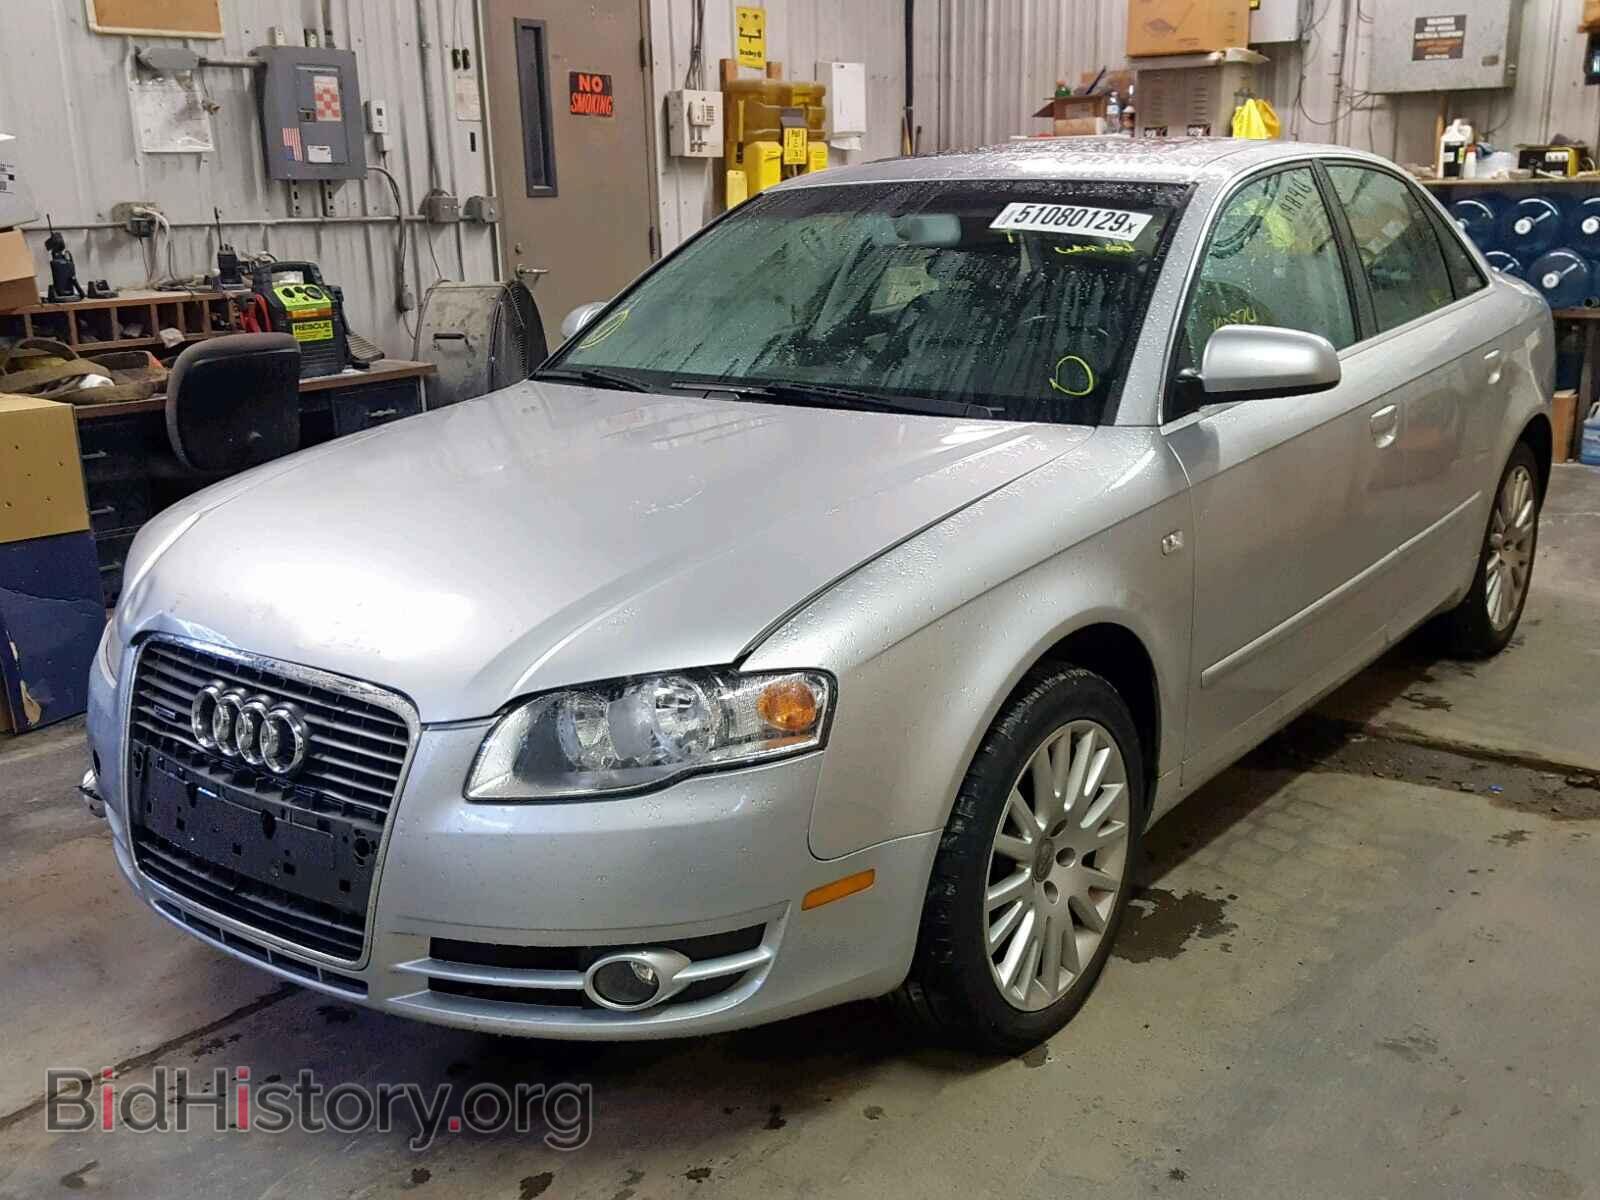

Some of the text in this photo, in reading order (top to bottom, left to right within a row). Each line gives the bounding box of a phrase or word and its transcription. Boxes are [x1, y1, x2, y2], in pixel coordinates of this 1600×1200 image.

[579, 74, 603, 93] NO
[571, 92, 613, 115] SMOKING
[296, 322, 330, 330] RESCUE
